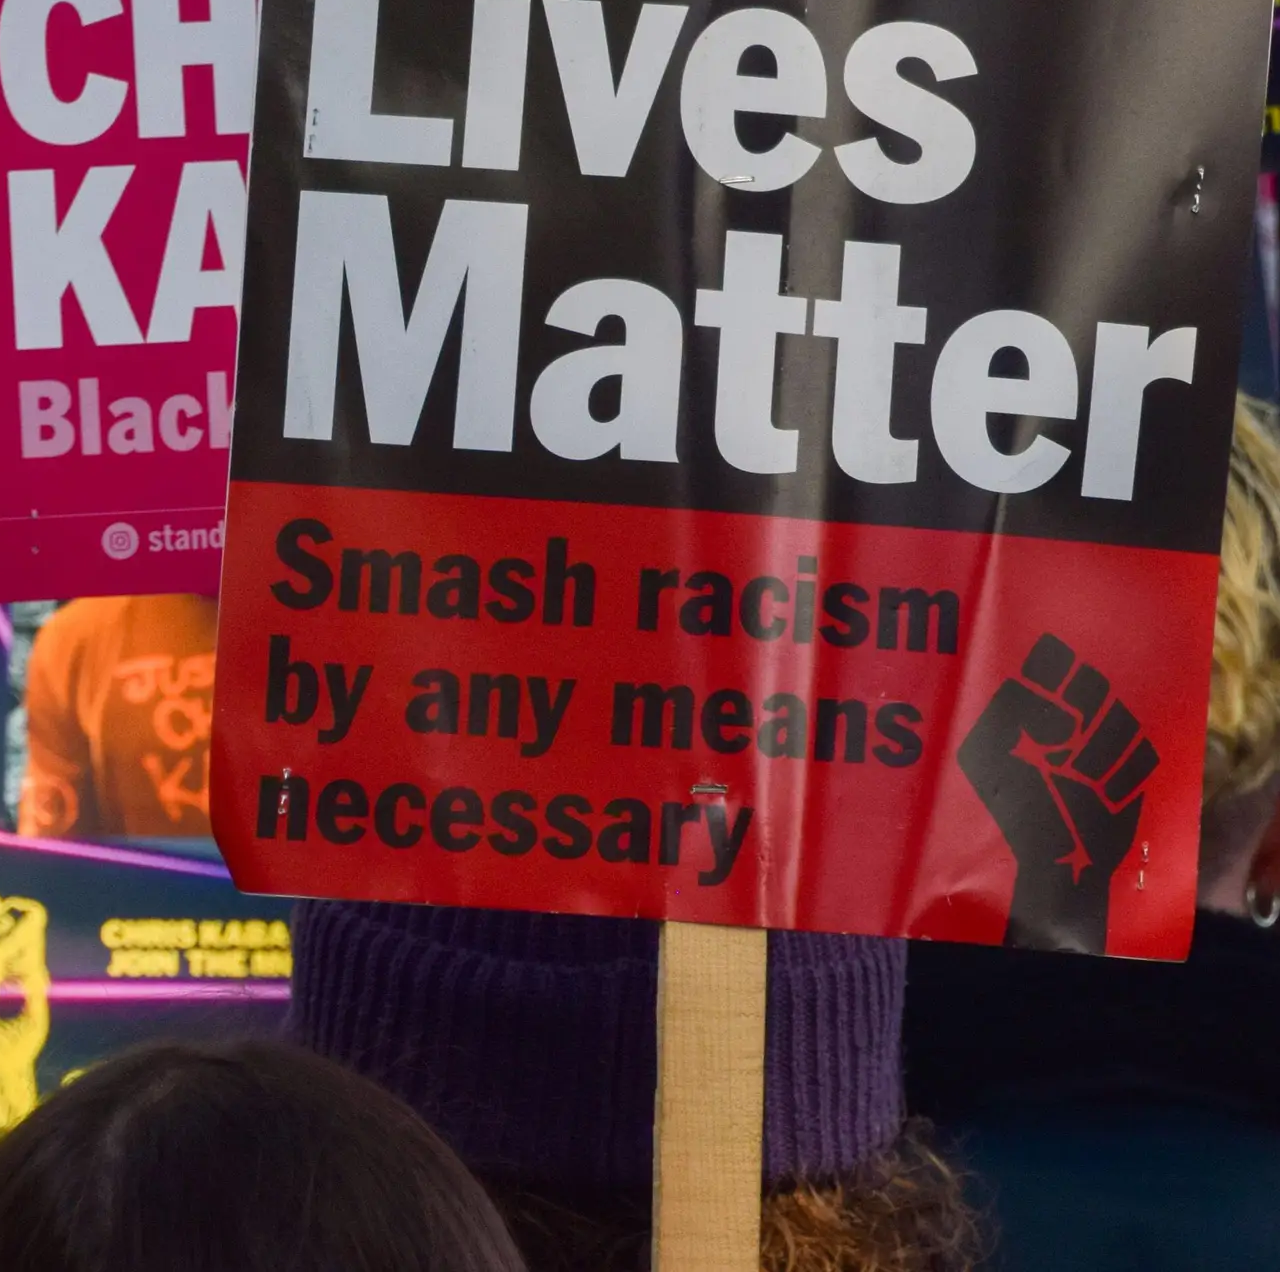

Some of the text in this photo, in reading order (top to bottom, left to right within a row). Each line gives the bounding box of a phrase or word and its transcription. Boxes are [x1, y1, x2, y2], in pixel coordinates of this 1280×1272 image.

[282, 189, 1198, 502] Matter
[269, 518, 961, 656] Smash racism
[265, 634, 375, 744] by
[404, 666, 577, 760] any
[611, 681, 926, 768] means
[255, 769, 755, 888] necessary
